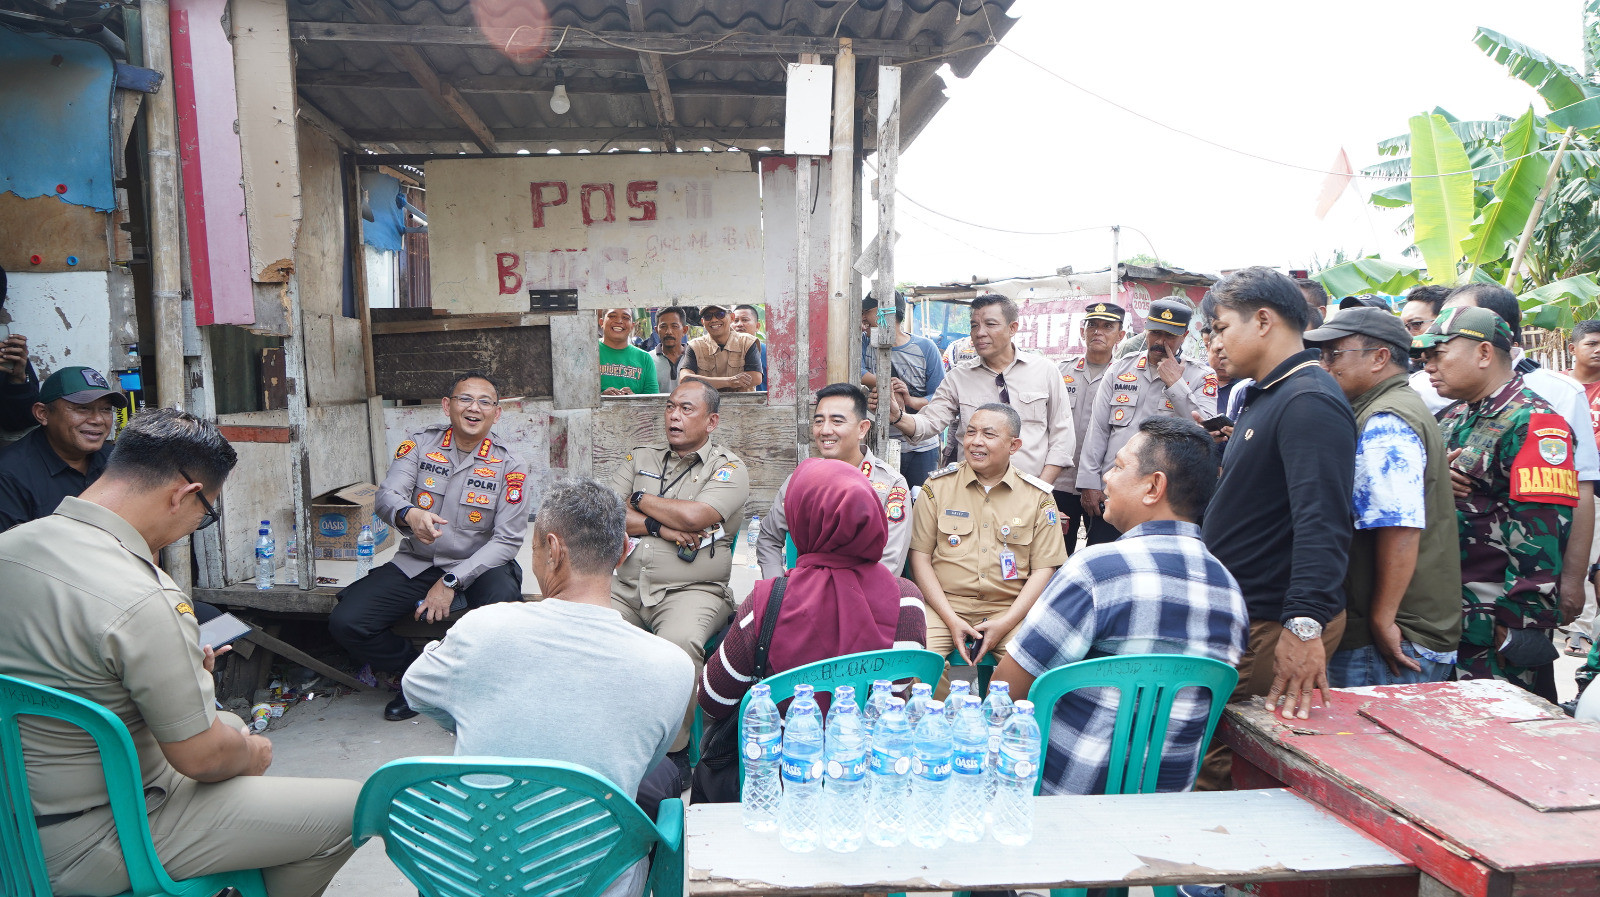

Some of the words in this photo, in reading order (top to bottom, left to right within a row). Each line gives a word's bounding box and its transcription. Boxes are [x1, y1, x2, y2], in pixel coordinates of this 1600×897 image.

[529, 180, 658, 228] POS
[1133, 300, 1151, 312] 2025
[600, 363, 643, 381] niversary
[419, 461, 450, 477] ERICK
[467, 478, 497, 491] POLRI
[1518, 467, 1578, 496] BABINSA
[321, 520, 345, 531] OASIS
[782, 761, 802, 776] OASIS
[955, 756, 978, 769] OASIS
